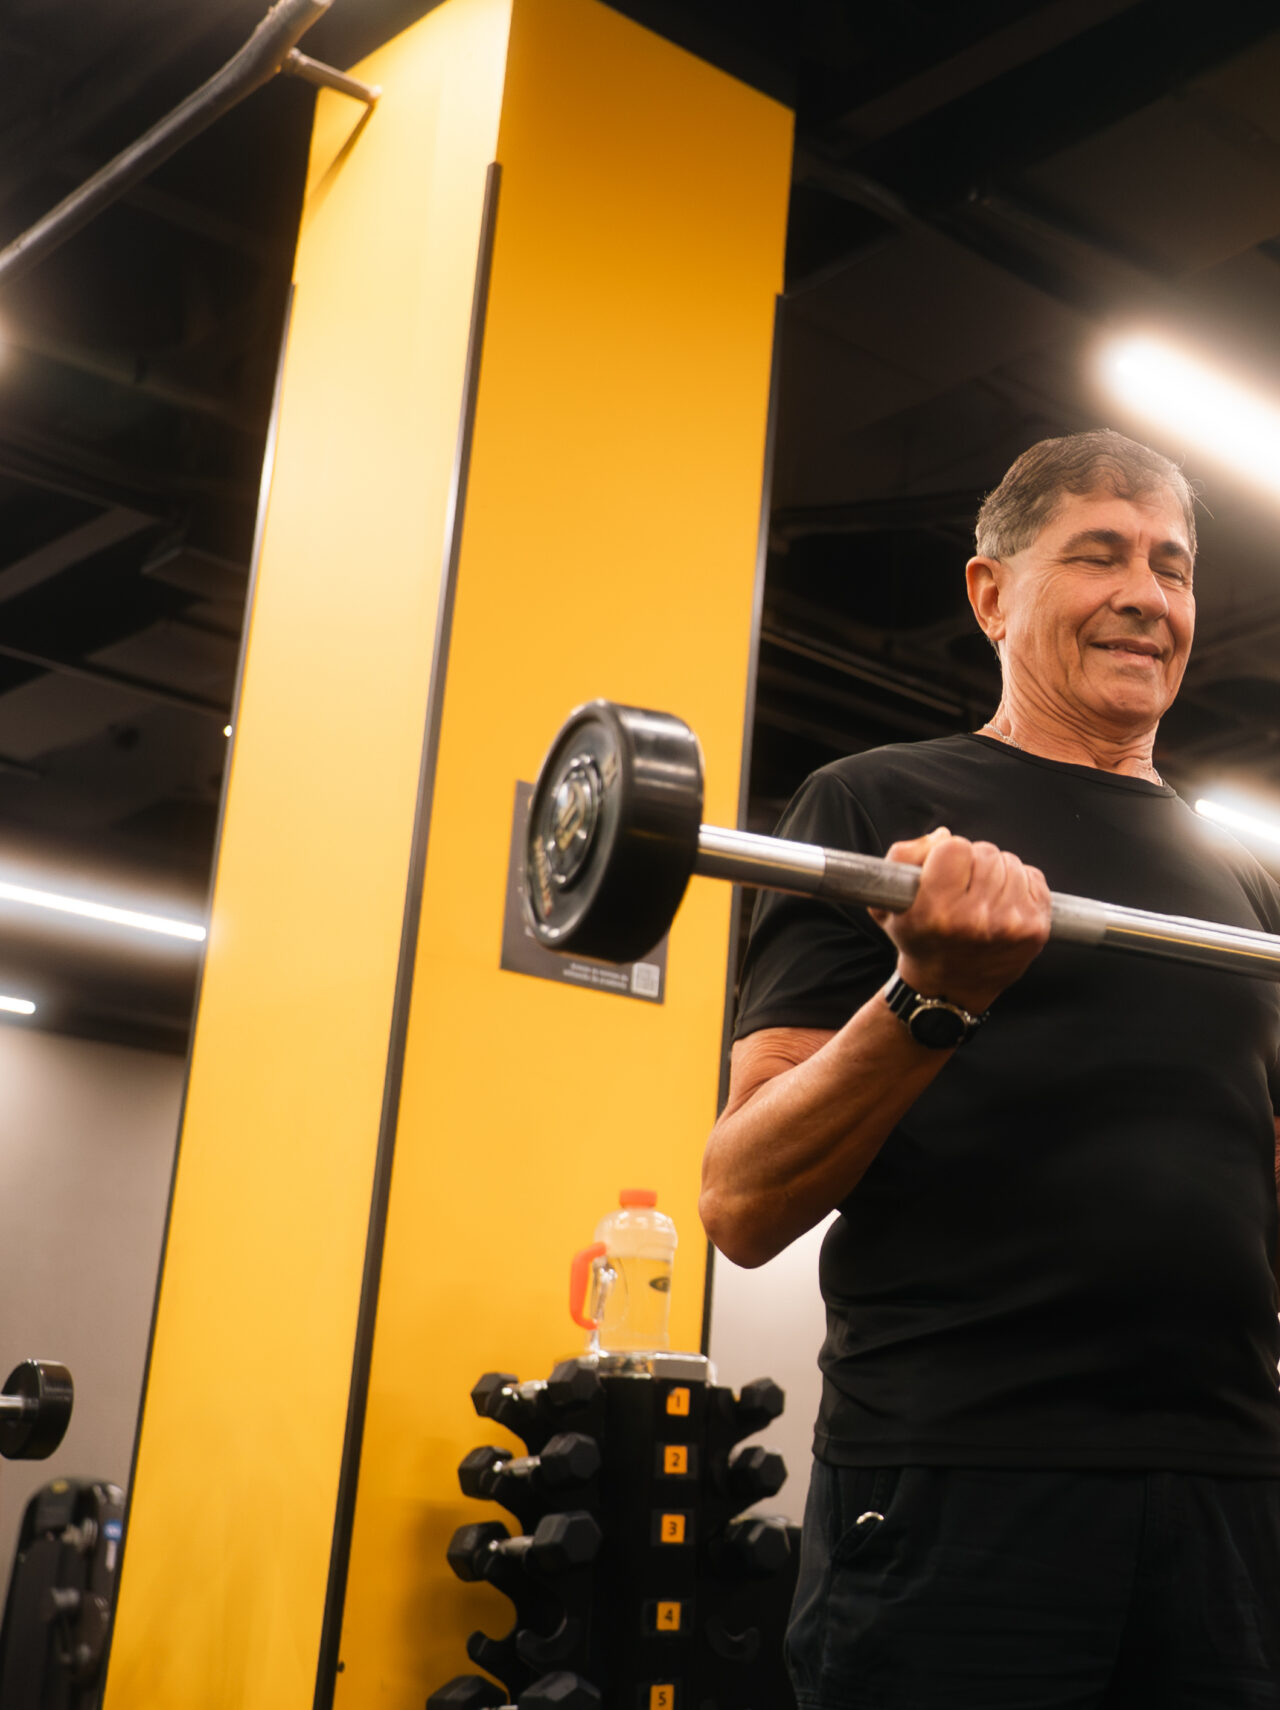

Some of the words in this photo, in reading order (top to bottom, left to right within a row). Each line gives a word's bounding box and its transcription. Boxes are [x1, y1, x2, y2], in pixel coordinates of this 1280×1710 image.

[671, 1452, 681, 1467] 2
[668, 1521, 678, 1537] 3
[664, 1608, 674, 1623] 4
[658, 1691, 667, 1707] 5
